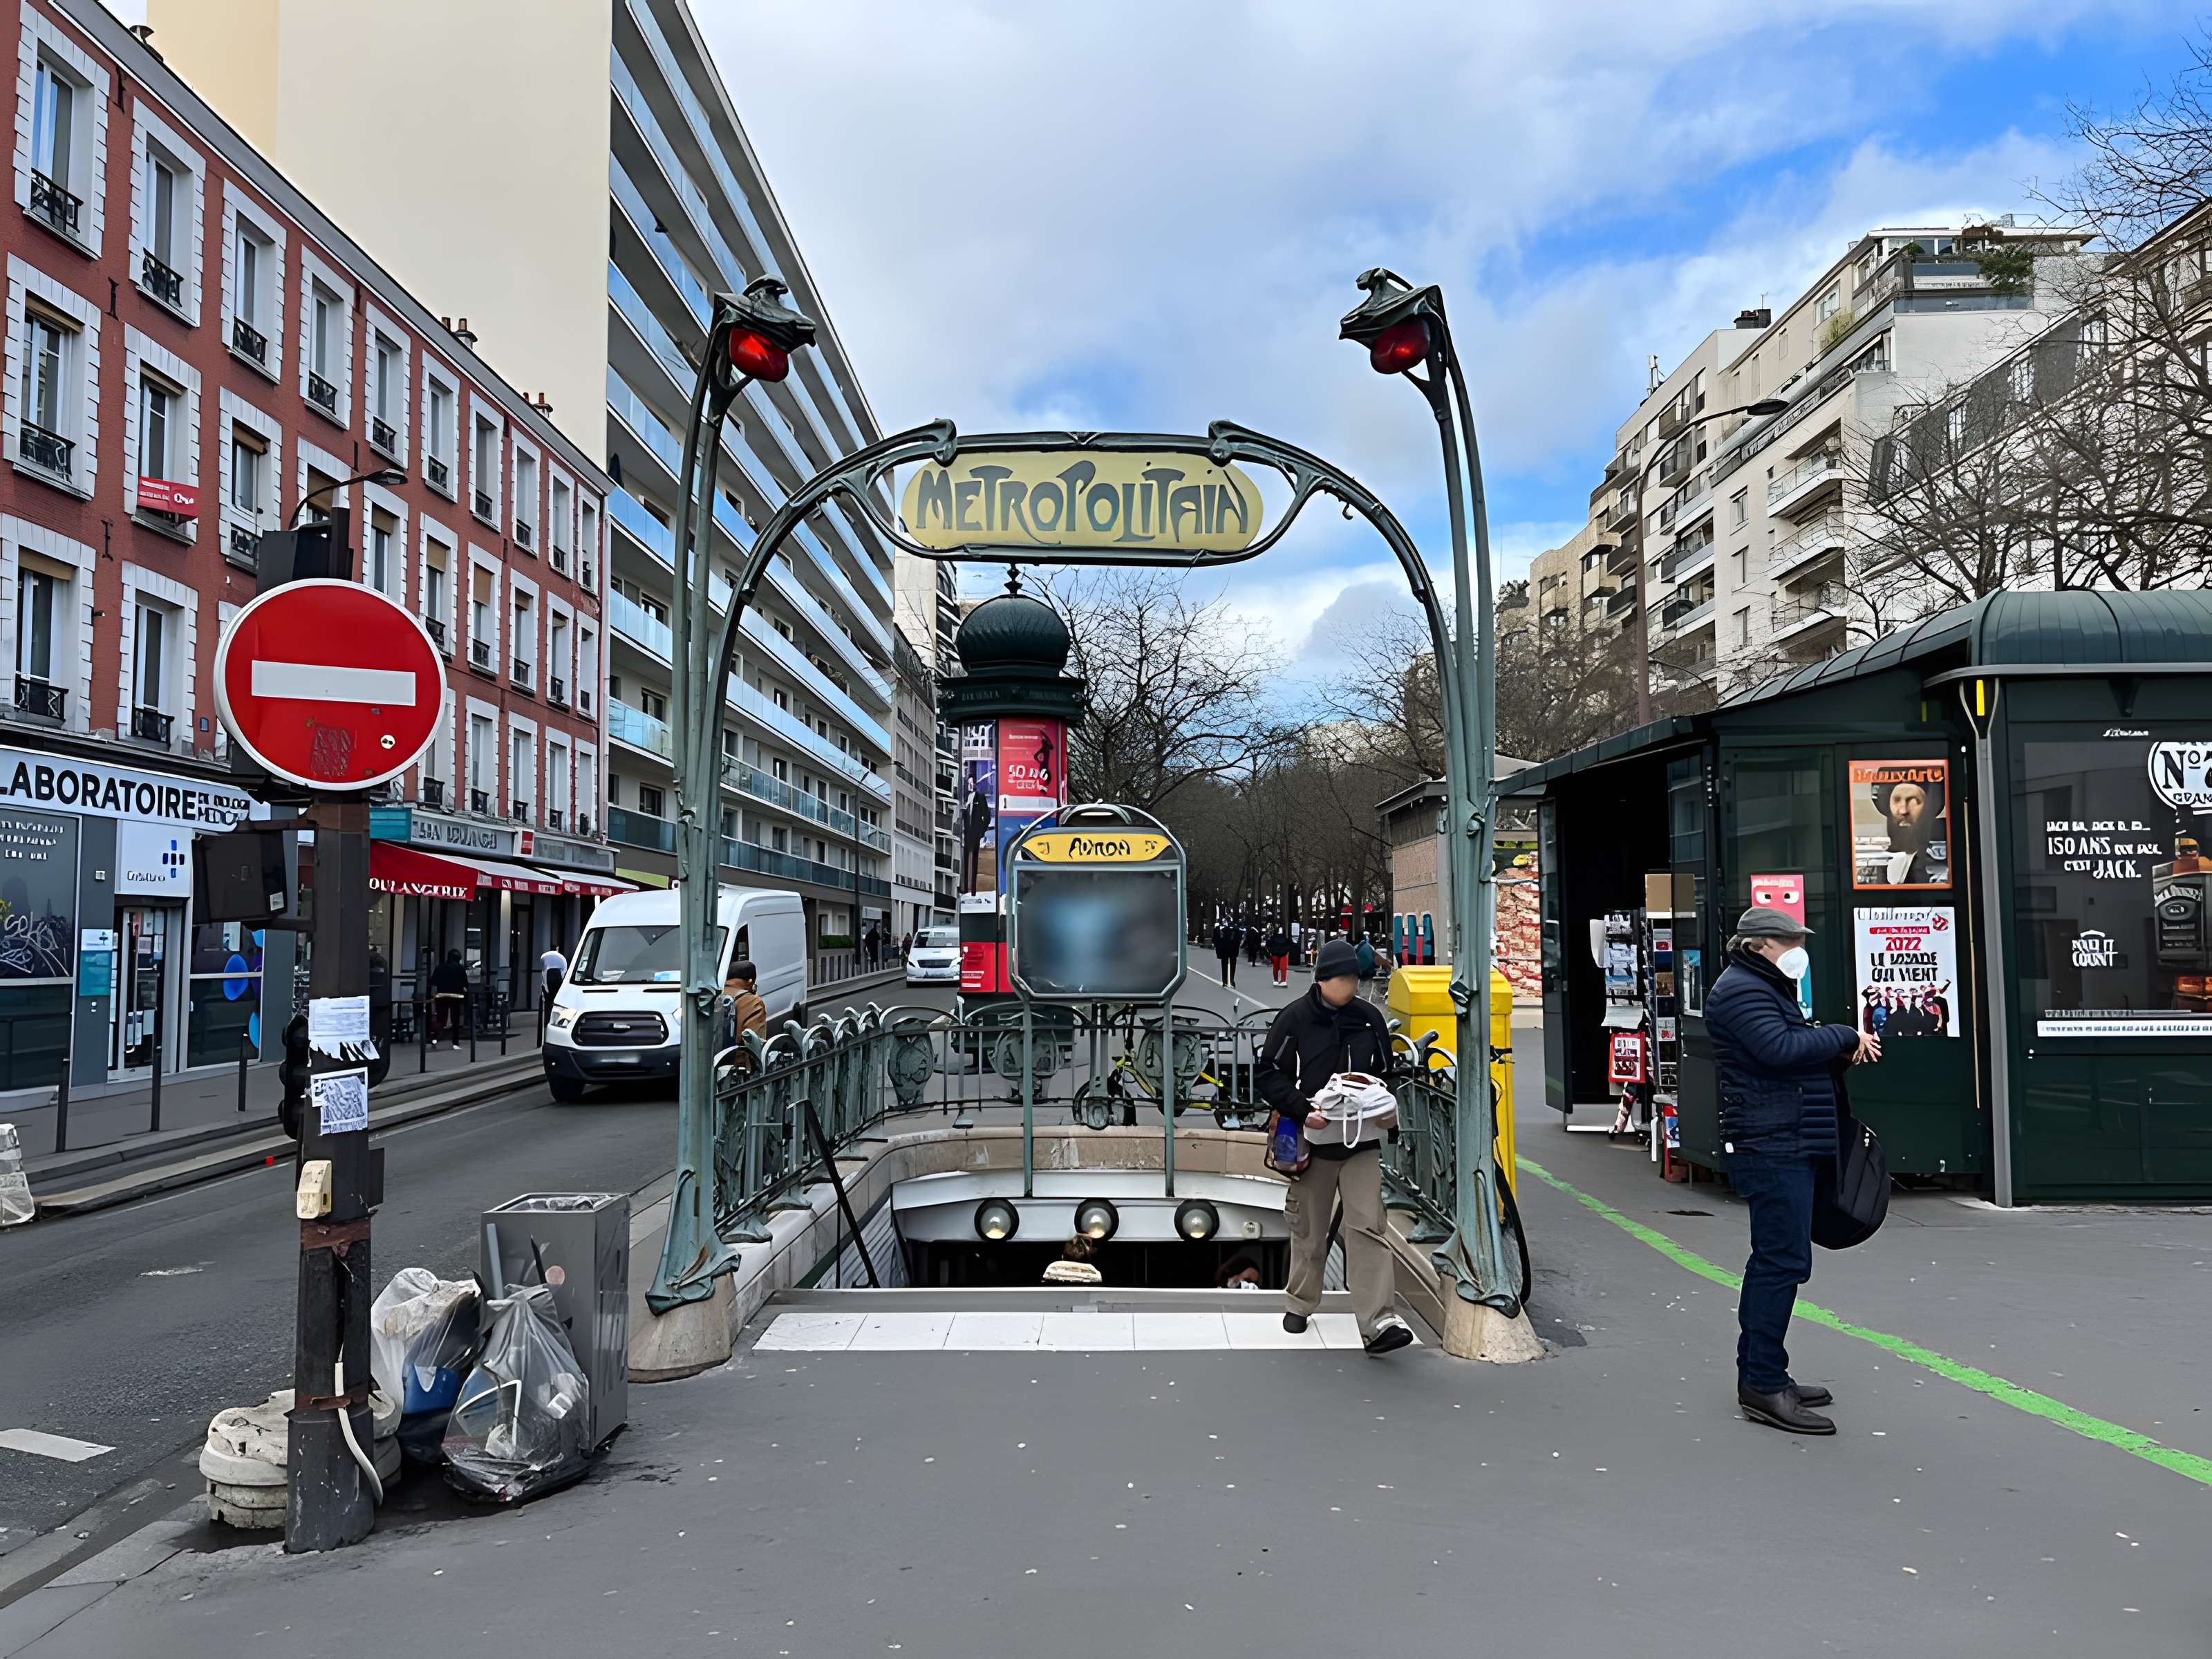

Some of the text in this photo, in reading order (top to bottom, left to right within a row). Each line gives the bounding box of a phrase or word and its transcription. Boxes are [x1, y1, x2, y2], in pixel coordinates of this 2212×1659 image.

[916, 460, 1248, 544] METROPOLITAIN
[2048, 836, 2076, 855] 150
[1885, 937, 1922, 951] 2022
